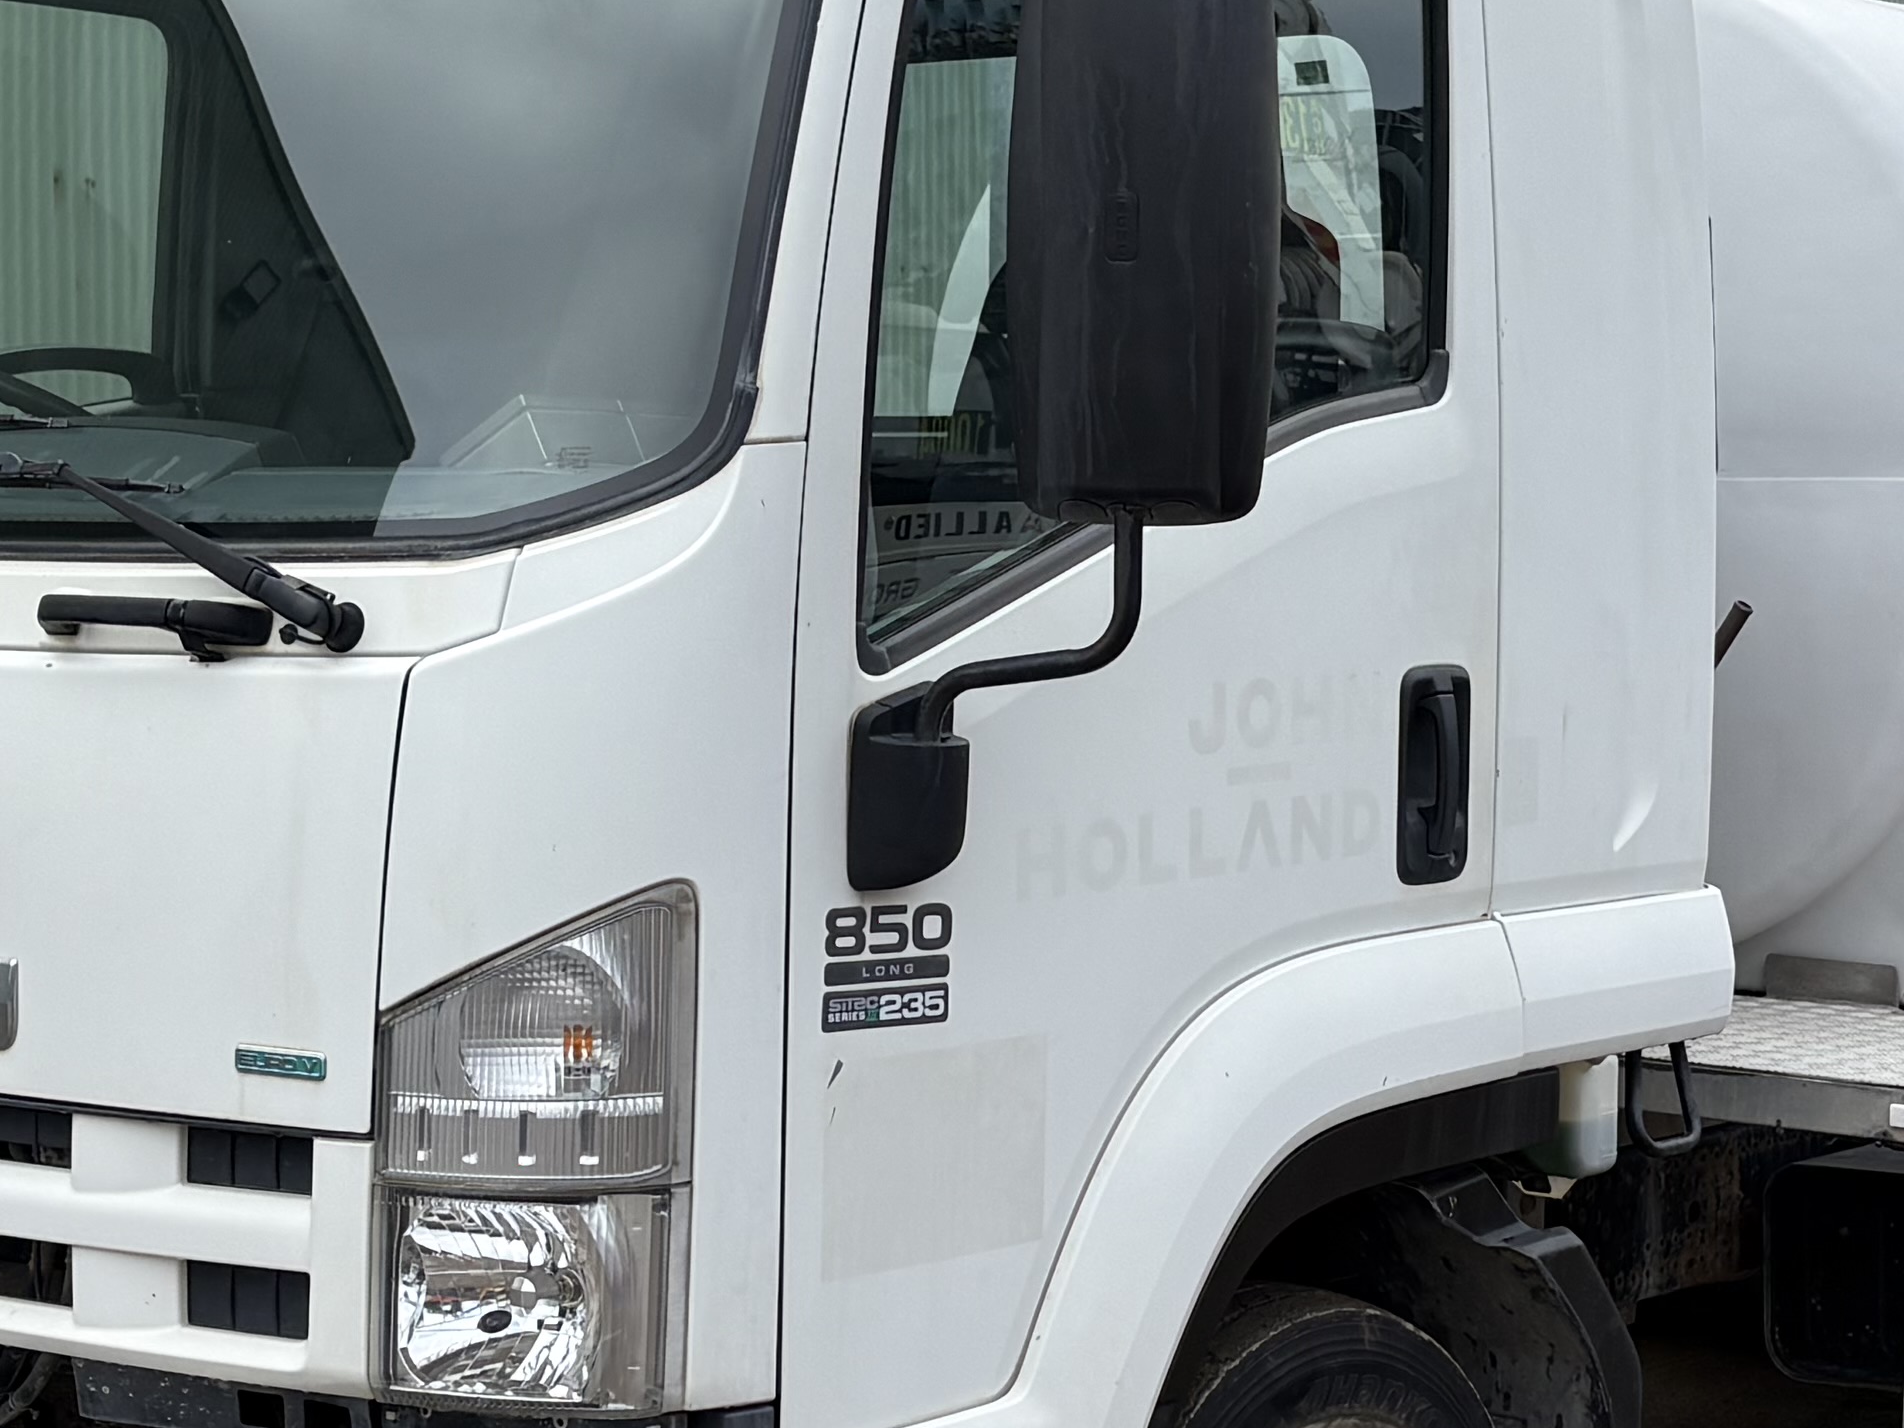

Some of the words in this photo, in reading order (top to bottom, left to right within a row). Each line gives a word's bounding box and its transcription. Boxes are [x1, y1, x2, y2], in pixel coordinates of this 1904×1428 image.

[1015, 788, 1382, 902] HOLLAND
[824, 902, 953, 957] 850
[862, 963, 914, 977] LONG
[827, 1011, 866, 1023] SERIES
[879, 990, 945, 1021] 235
